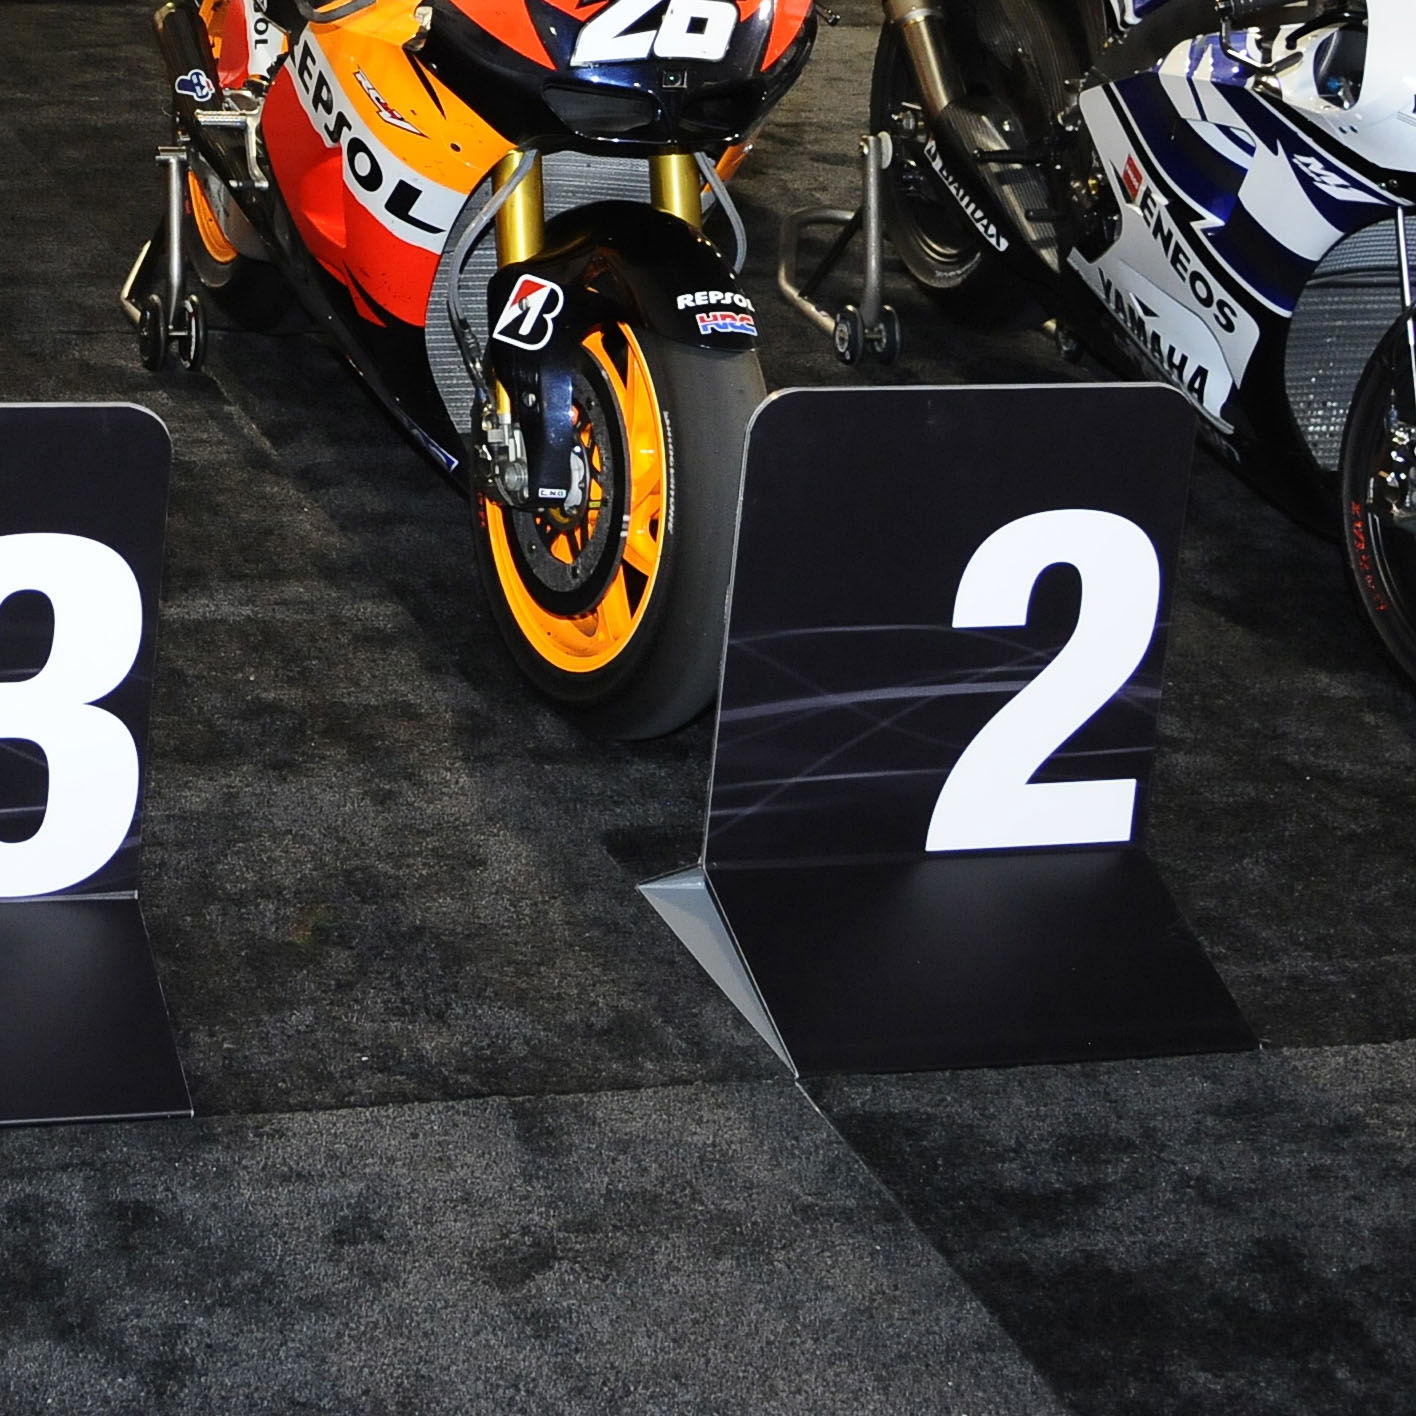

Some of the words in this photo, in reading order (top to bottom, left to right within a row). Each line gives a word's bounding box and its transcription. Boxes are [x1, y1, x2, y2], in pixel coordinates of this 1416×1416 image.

[290, 39, 447, 235] EPSOL
[676, 290, 756, 312] REPSOL
[695, 312, 758, 336] HRC
[1136, 186, 1239, 334] ENEOS
[1097, 267, 1210, 406] YAMAHA
[926, 508, 1161, 853] 2
